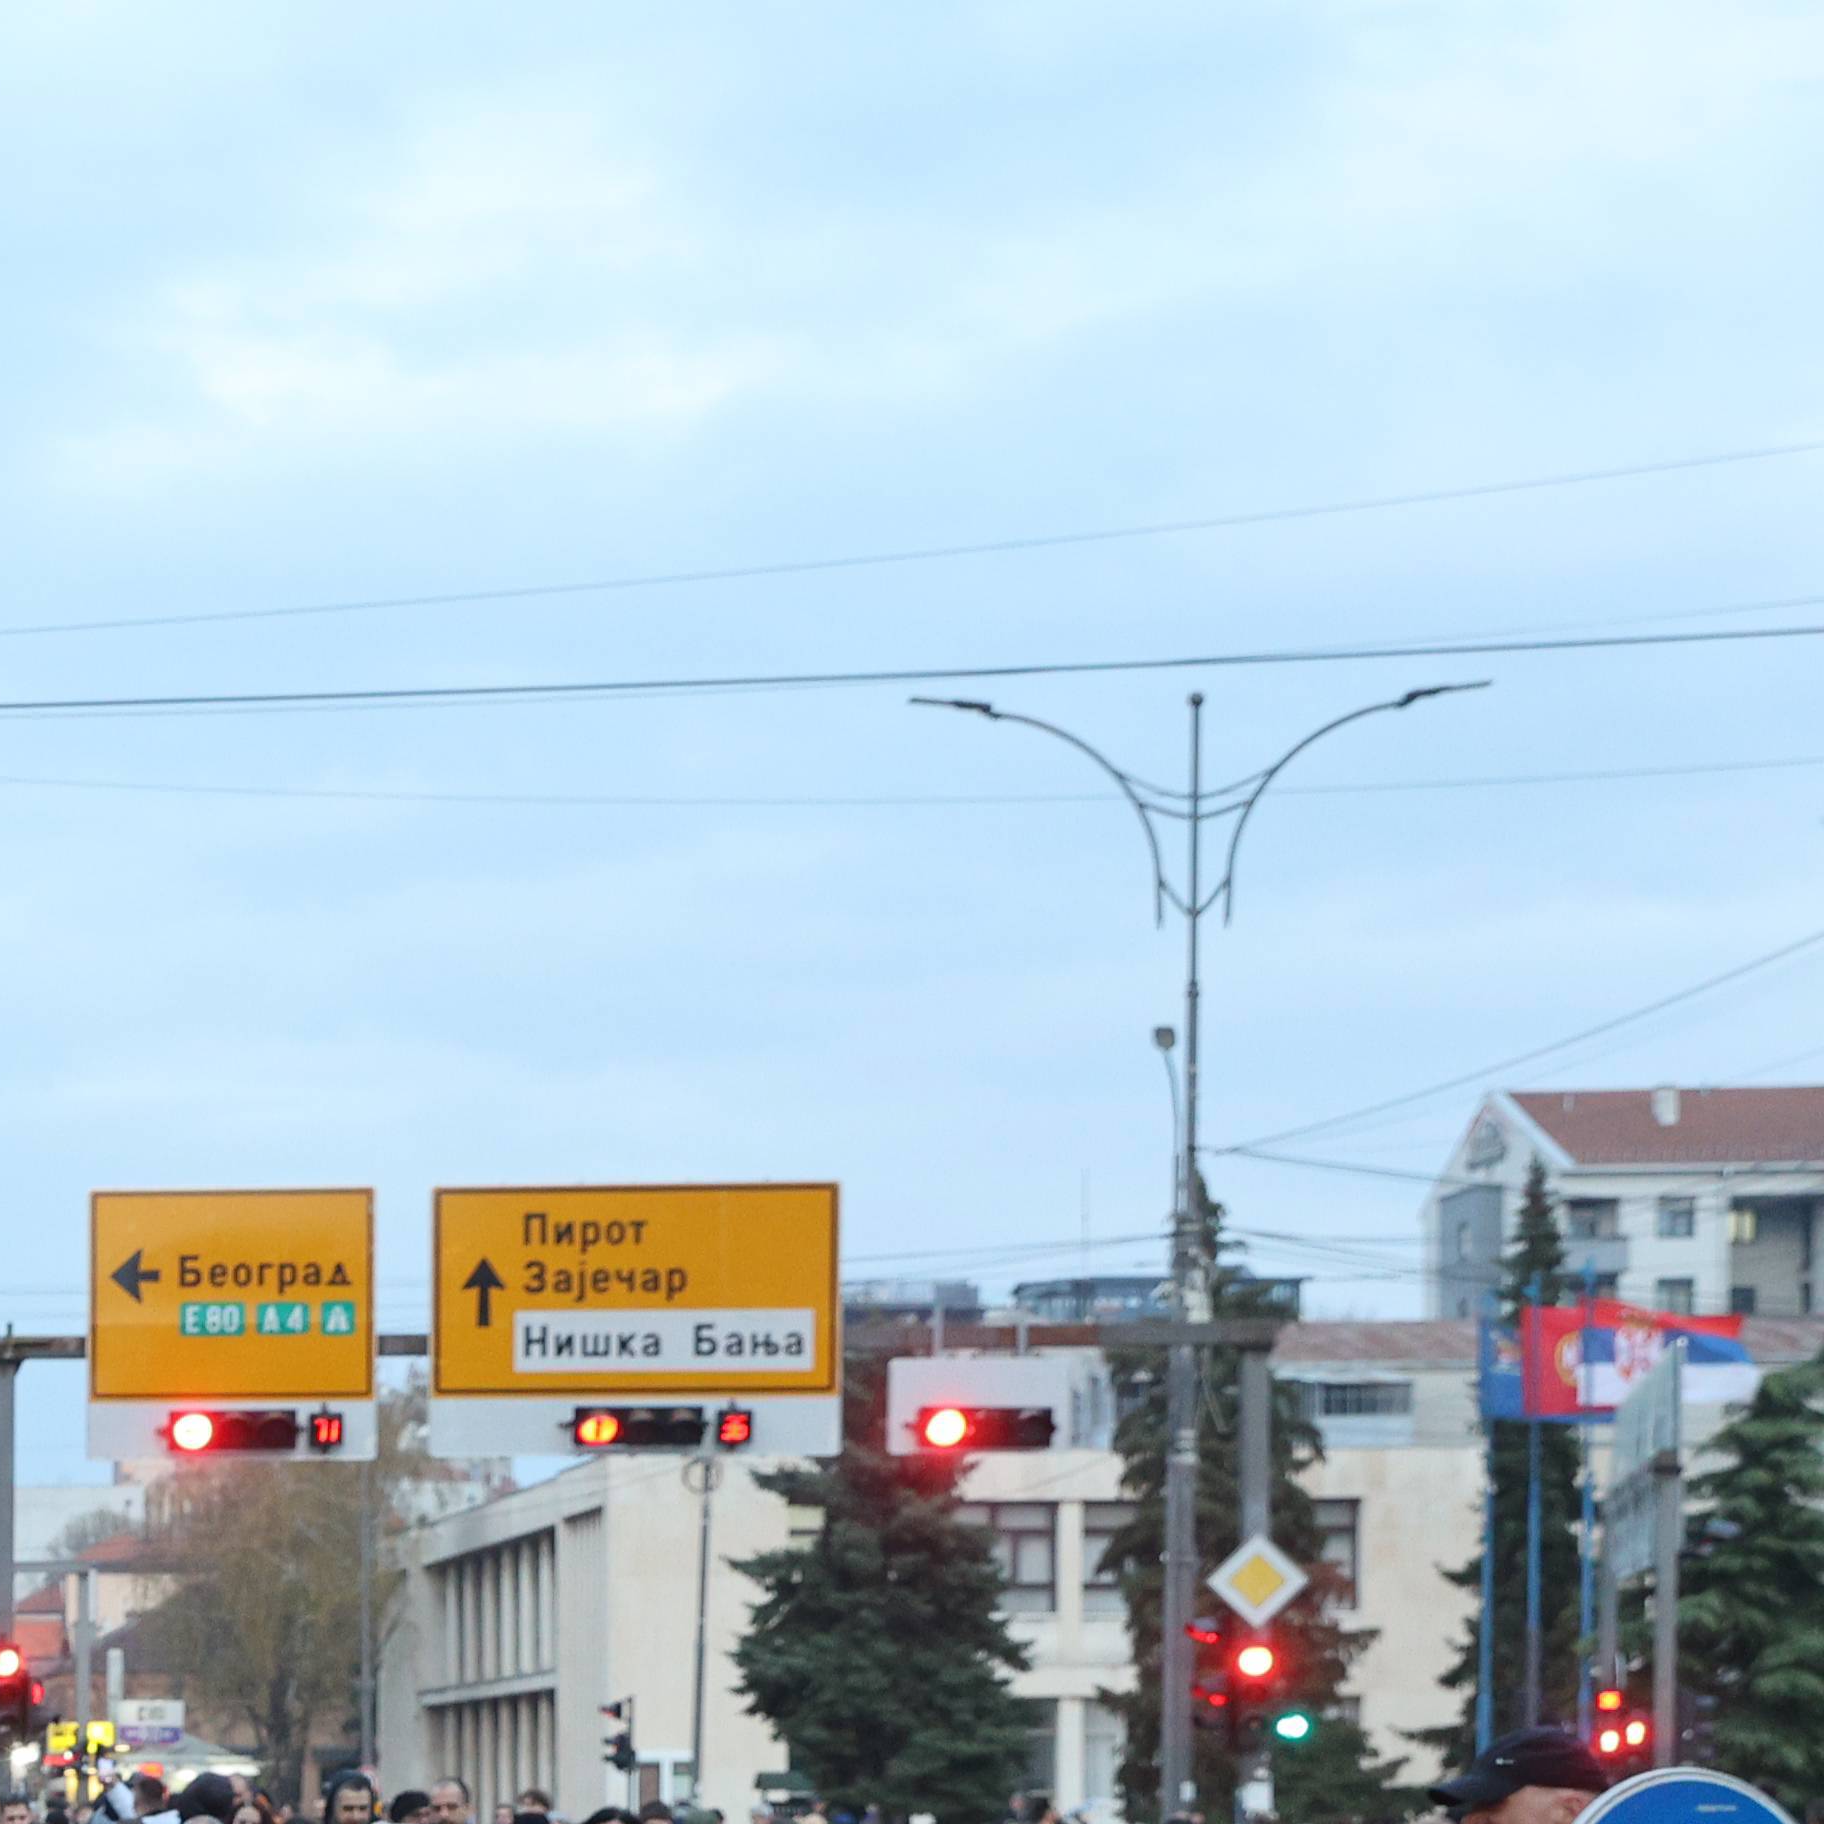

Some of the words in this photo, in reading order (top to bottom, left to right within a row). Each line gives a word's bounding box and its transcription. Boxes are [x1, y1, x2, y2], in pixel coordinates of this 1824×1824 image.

[522, 1212, 648, 1252] Пирот
[178, 1254, 352, 1295] Београд
[522, 1260, 689, 1302] Зајечар
[184, 1304, 201, 1333] E
[205, 1304, 241, 1333] 80
[262, 1304, 280, 1333] A
[286, 1304, 303, 1332] 4
[523, 1324, 661, 1358] Нишка
[693, 1322, 804, 1358] Бања
